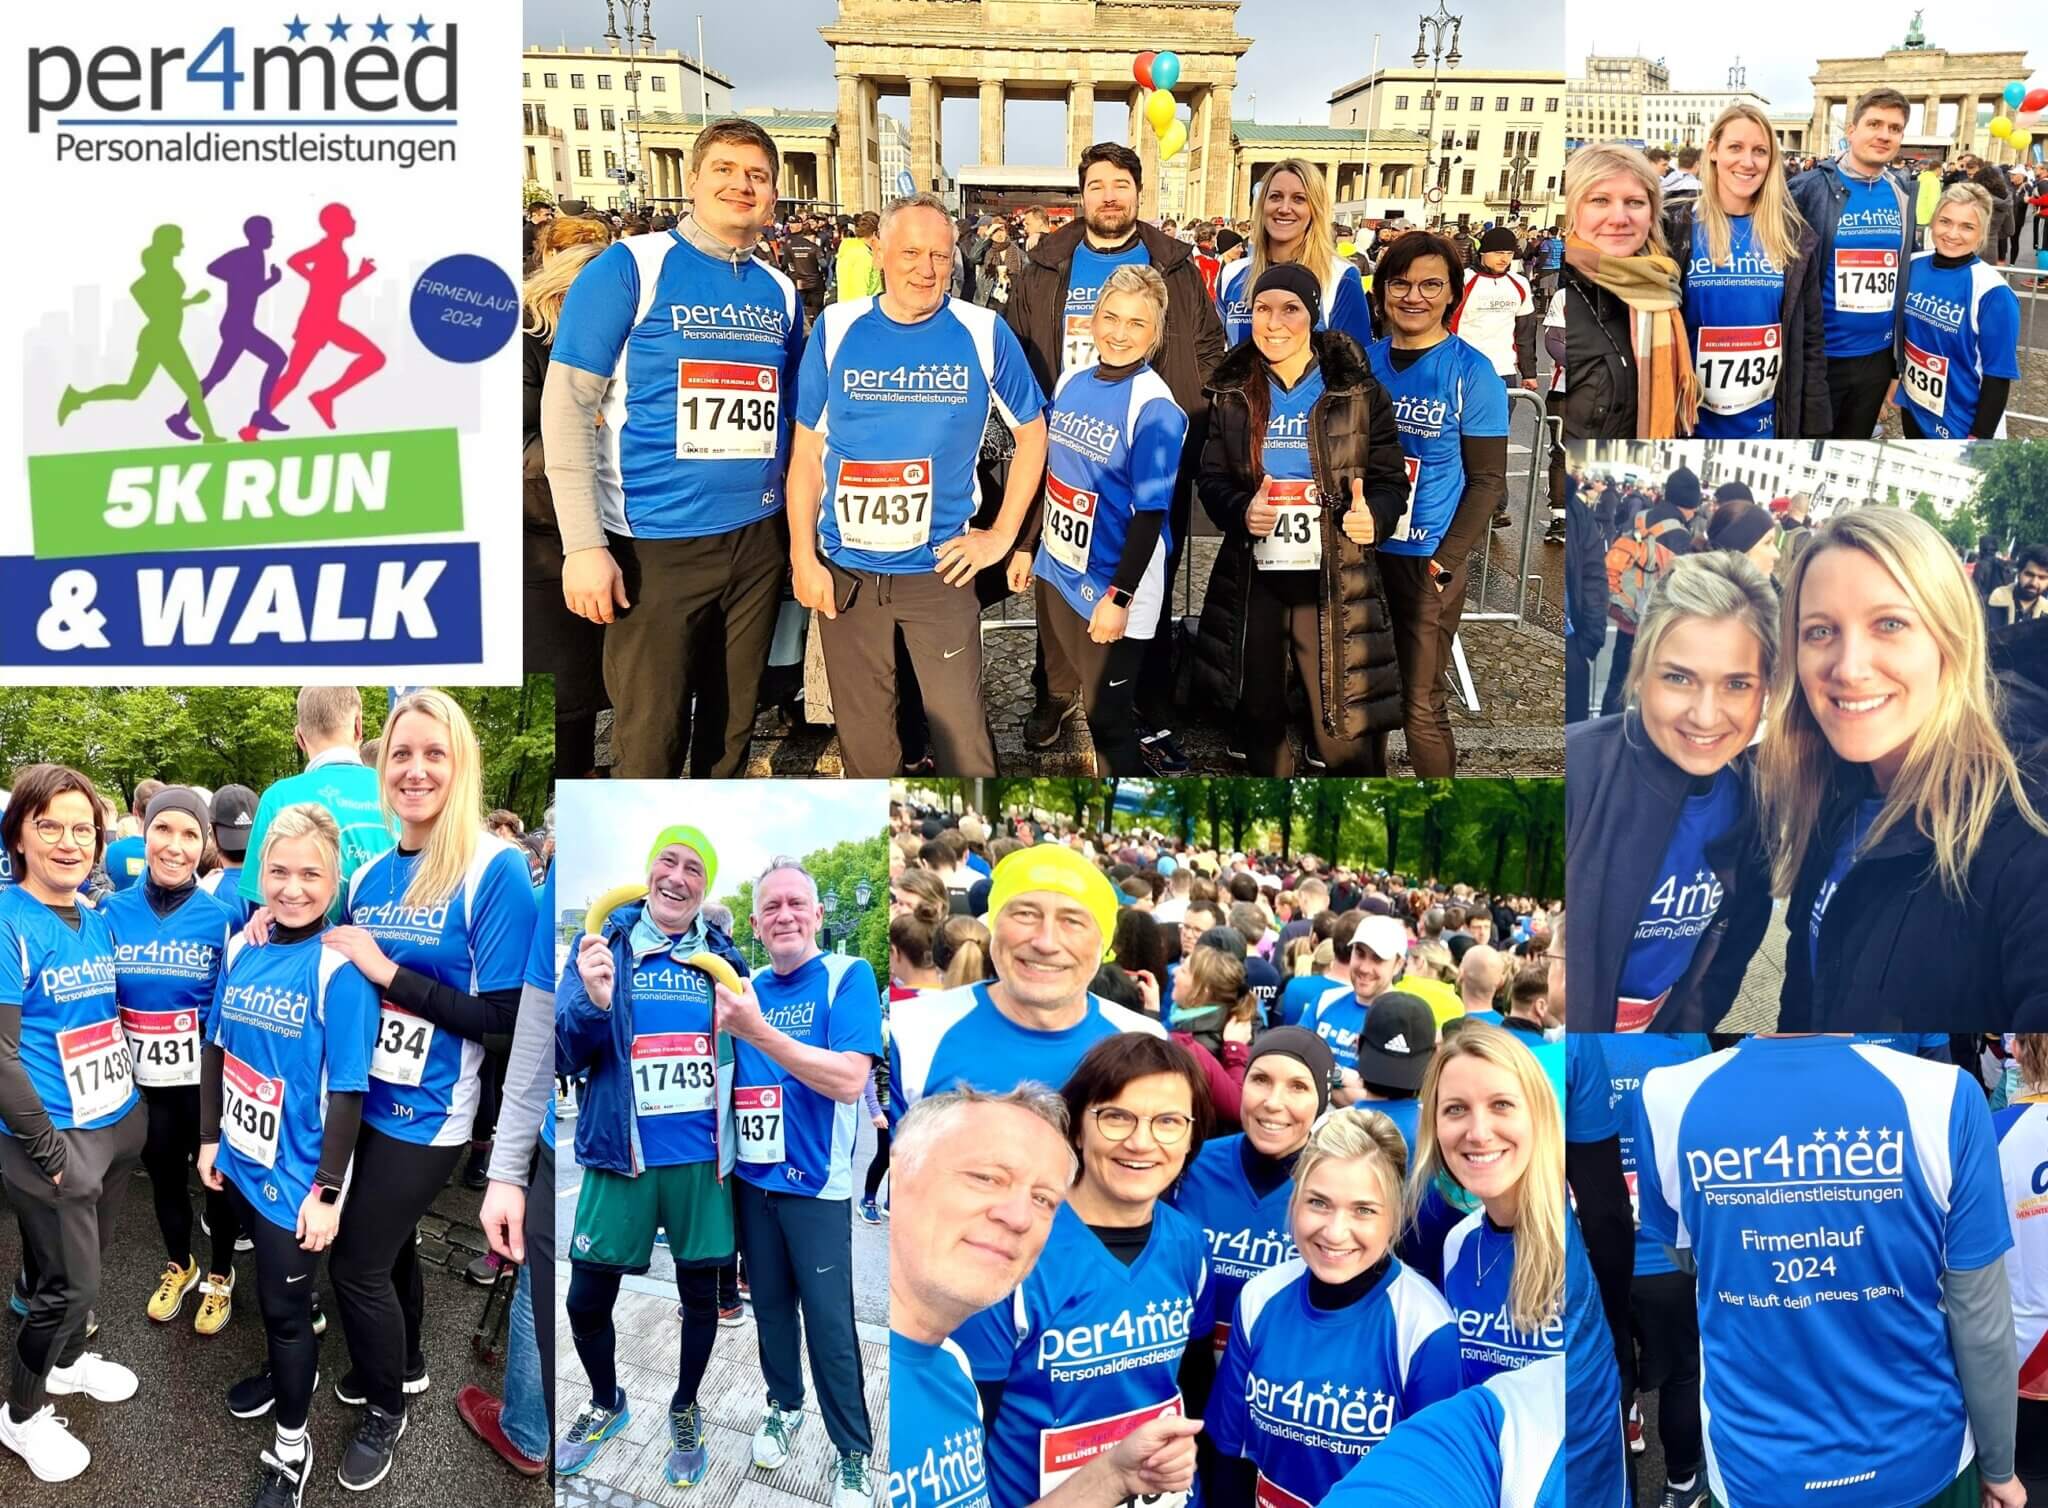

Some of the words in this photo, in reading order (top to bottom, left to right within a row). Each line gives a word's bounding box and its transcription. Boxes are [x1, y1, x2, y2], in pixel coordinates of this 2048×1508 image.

[27, 23, 458, 133] per4med
[56, 133, 457, 168] Personaldienstleistungen
[417, 278, 518, 313] FIRMENLAUF
[1838, 271, 1896, 294] 17436
[440, 307, 483, 329] 2024
[671, 303, 785, 333] per4med
[843, 366, 969, 391] per4med
[1700, 355, 1779, 389] 17434
[849, 391, 968, 403] Personaldienstleistungen
[682, 397, 776, 431] 17436
[103, 462, 210, 528] 5K
[222, 450, 390, 521] RUN
[761, 491, 775, 506] RS
[838, 492, 929, 525] 17437
[36, 570, 111, 652] &
[136, 559, 448, 647] WALK
[1080, 583, 1094, 602] KB
[69, 1046, 133, 1097] 17438
[635, 1061, 715, 1092] 17433
[391, 1103, 414, 1120] JM
[786, 1167, 805, 1181] RT
[1686, 1130, 1904, 1191] per4med
[263, 1183, 278, 1202] KB
[1705, 1185, 1904, 1206] Personaldienstleistungen
[1741, 1226, 1865, 1252] Firmenlauf
[1772, 1256, 1837, 1285] 2024
[1718, 1291, 1744, 1306] Hier
[1748, 1293, 1781, 1308] läuft
[1783, 1295, 1813, 1310] dein
[1815, 1289, 1859, 1302] neues
[1862, 1284, 1905, 1301] Team!
[1055, 1446, 1099, 1464] BERLINER
